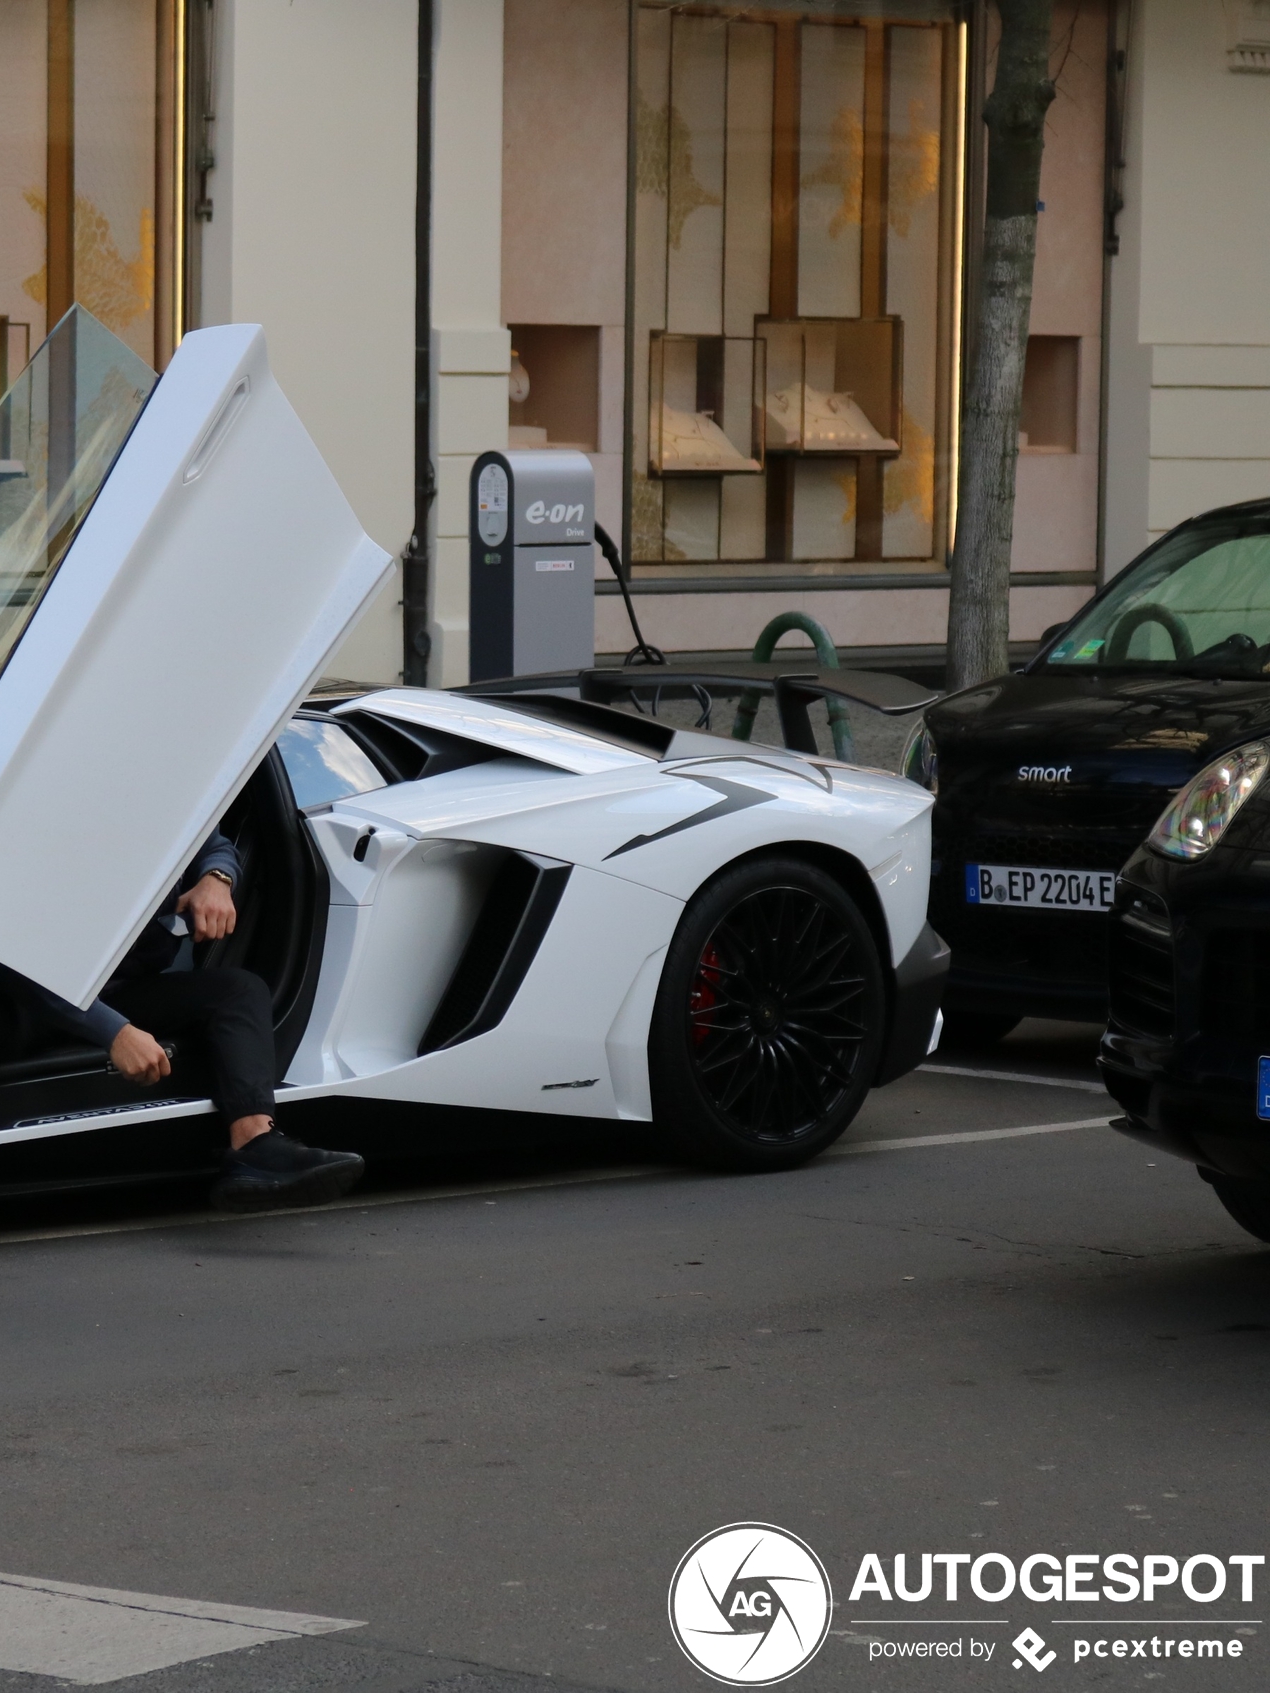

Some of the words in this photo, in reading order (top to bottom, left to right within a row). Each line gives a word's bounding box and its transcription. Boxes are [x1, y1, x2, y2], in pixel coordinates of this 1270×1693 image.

[566, 528, 585, 537] Drive
[1017, 765, 1072, 783] smart
[980, 869, 994, 900] B
[1008, 871, 1035, 902] EP
